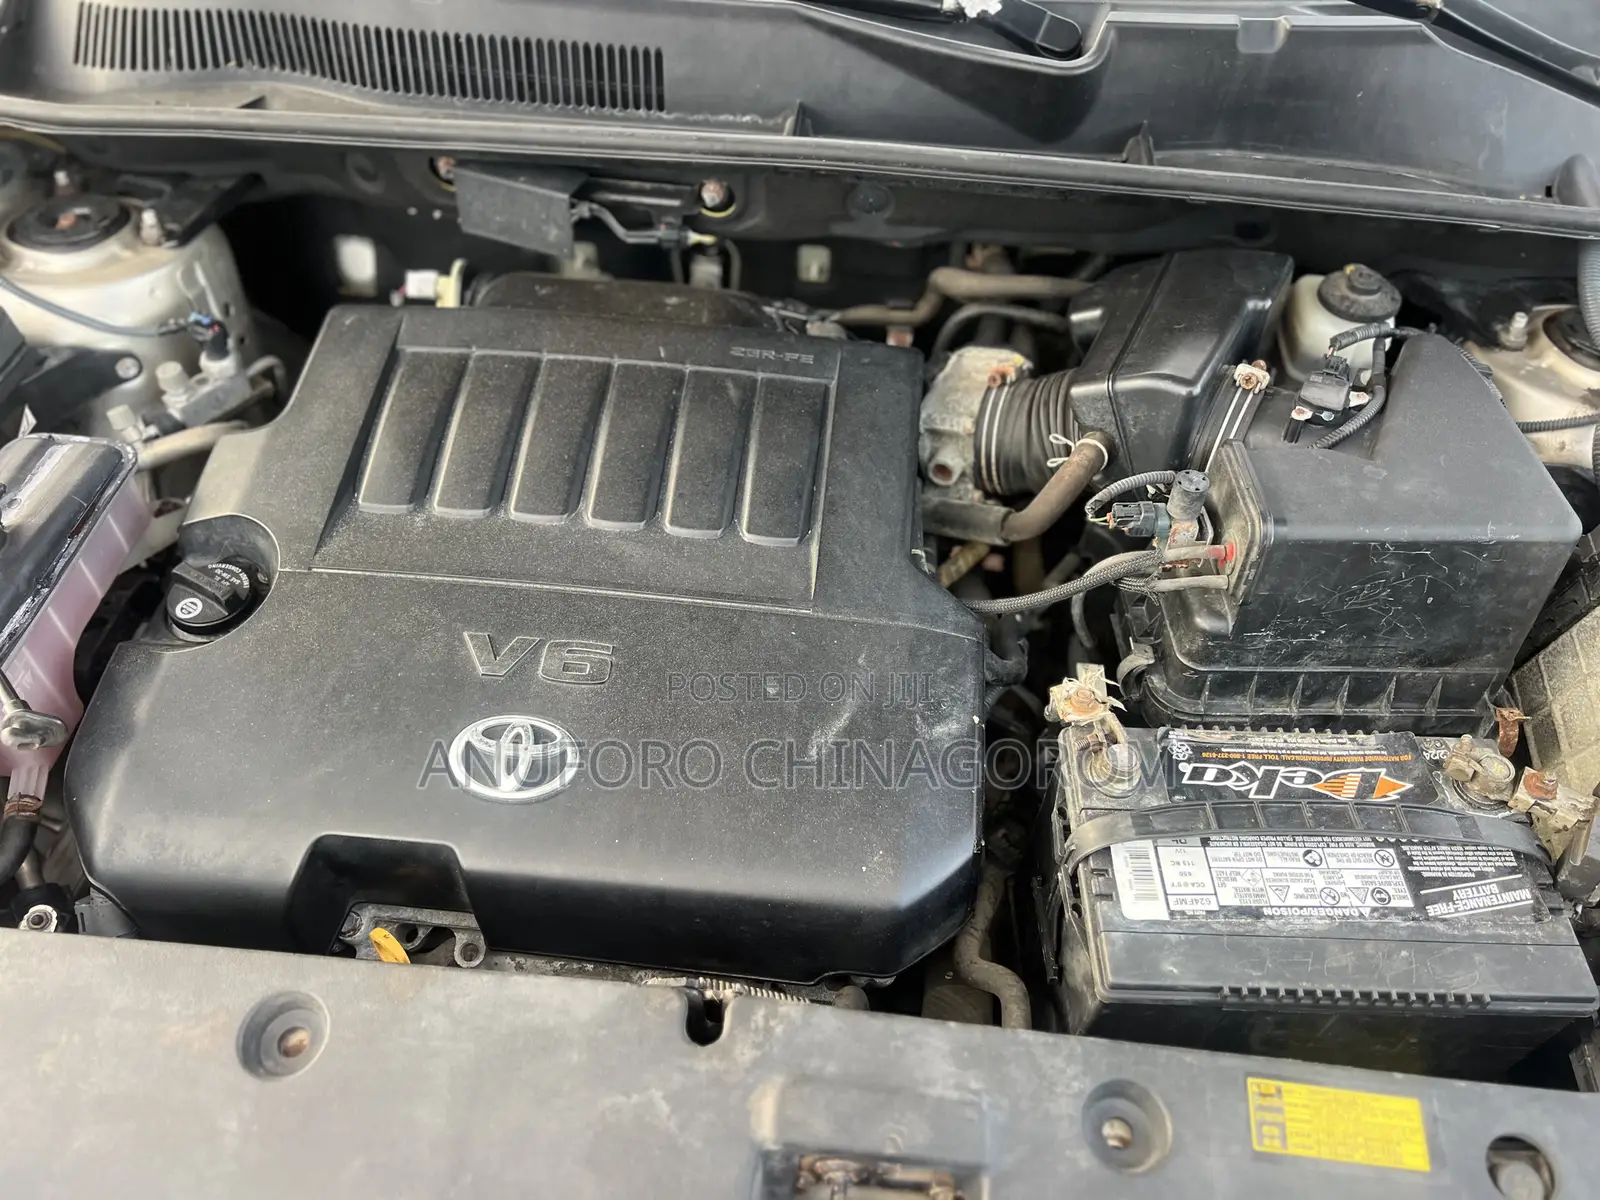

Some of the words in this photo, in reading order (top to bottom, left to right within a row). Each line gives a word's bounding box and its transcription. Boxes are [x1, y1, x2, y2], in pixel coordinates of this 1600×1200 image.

[463, 632, 615, 685] V6
[1180, 760, 1414, 801] Deka
[1173, 897, 1211, 905] 624FMF
[1425, 888, 1532, 916] MAINTENANCE-FREE
[1452, 883, 1499, 901] BATTERY
[1263, 907, 1359, 916] DANGER/POISON
